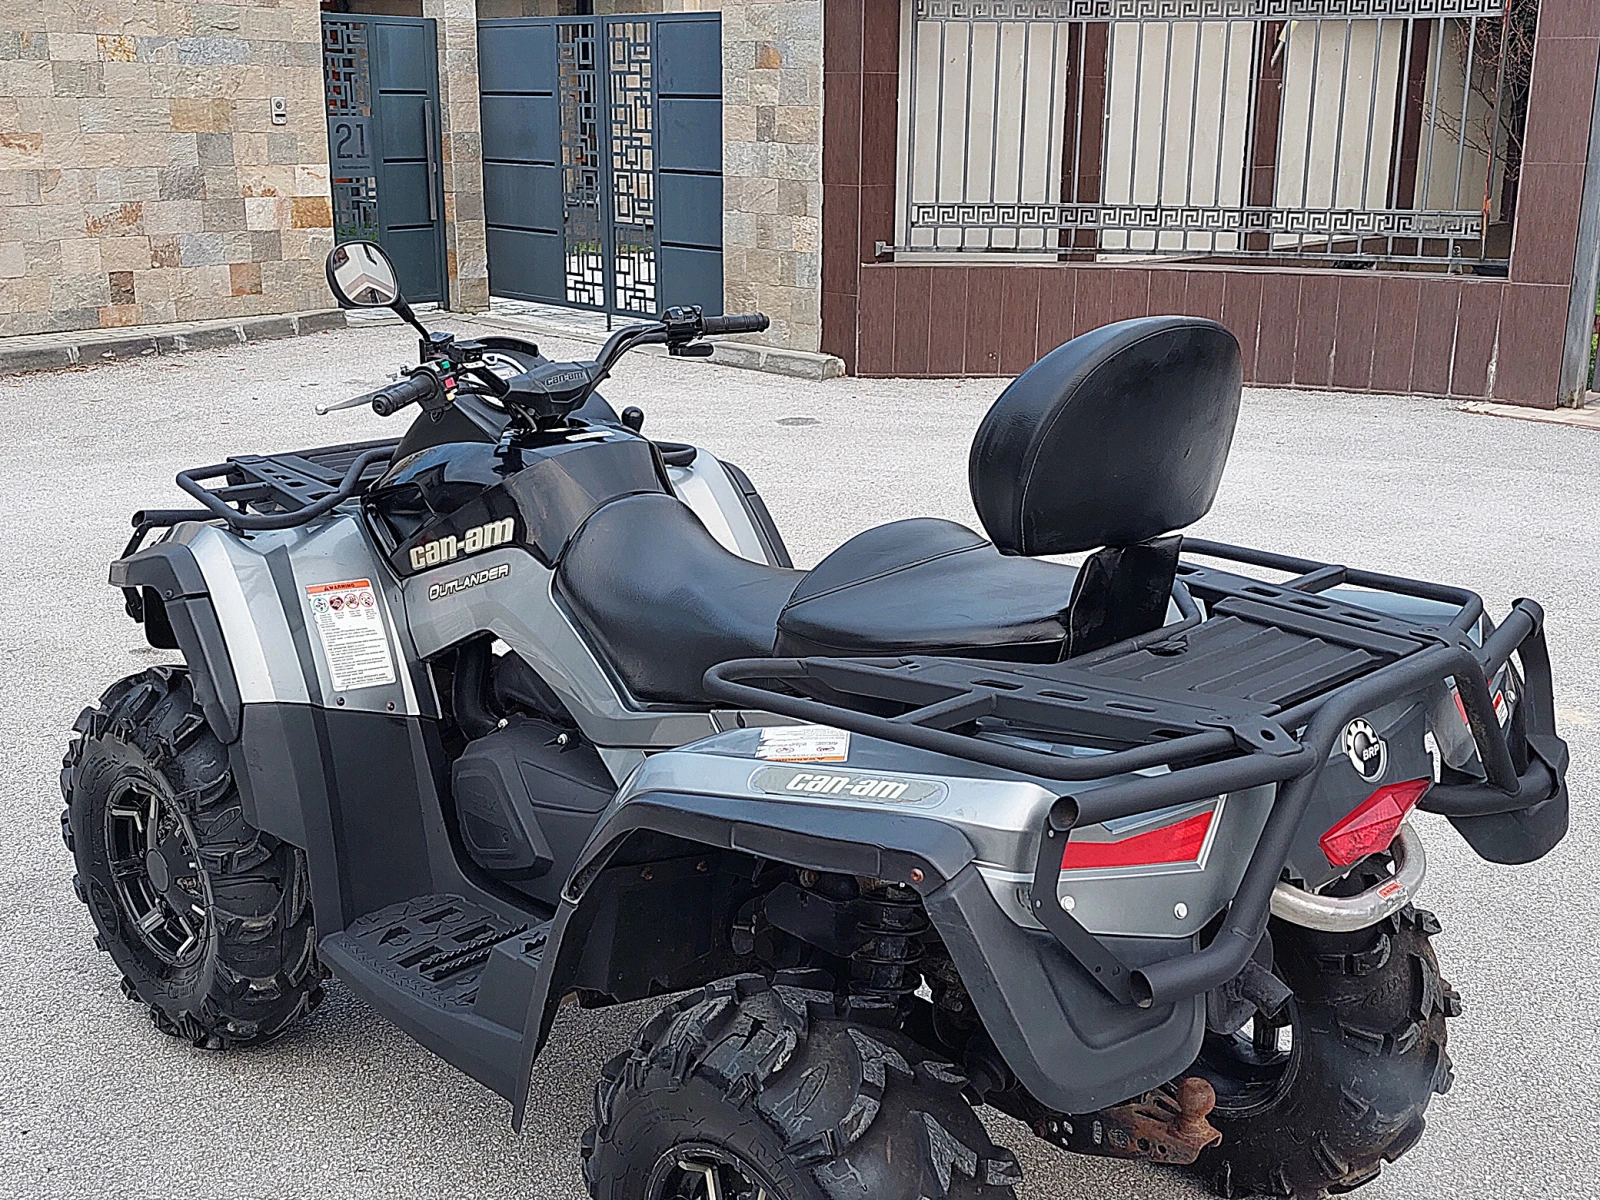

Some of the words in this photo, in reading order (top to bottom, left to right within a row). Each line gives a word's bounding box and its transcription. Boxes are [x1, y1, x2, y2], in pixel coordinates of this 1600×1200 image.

[335, 124, 369, 158] 21
[545, 372, 583, 386] can-am
[410, 517, 514, 570] can-am
[328, 582, 356, 591] WARNING
[429, 564, 510, 601] OUTLANDER
[1363, 744, 1379, 761] BRP
[786, 774, 908, 798] can-am
